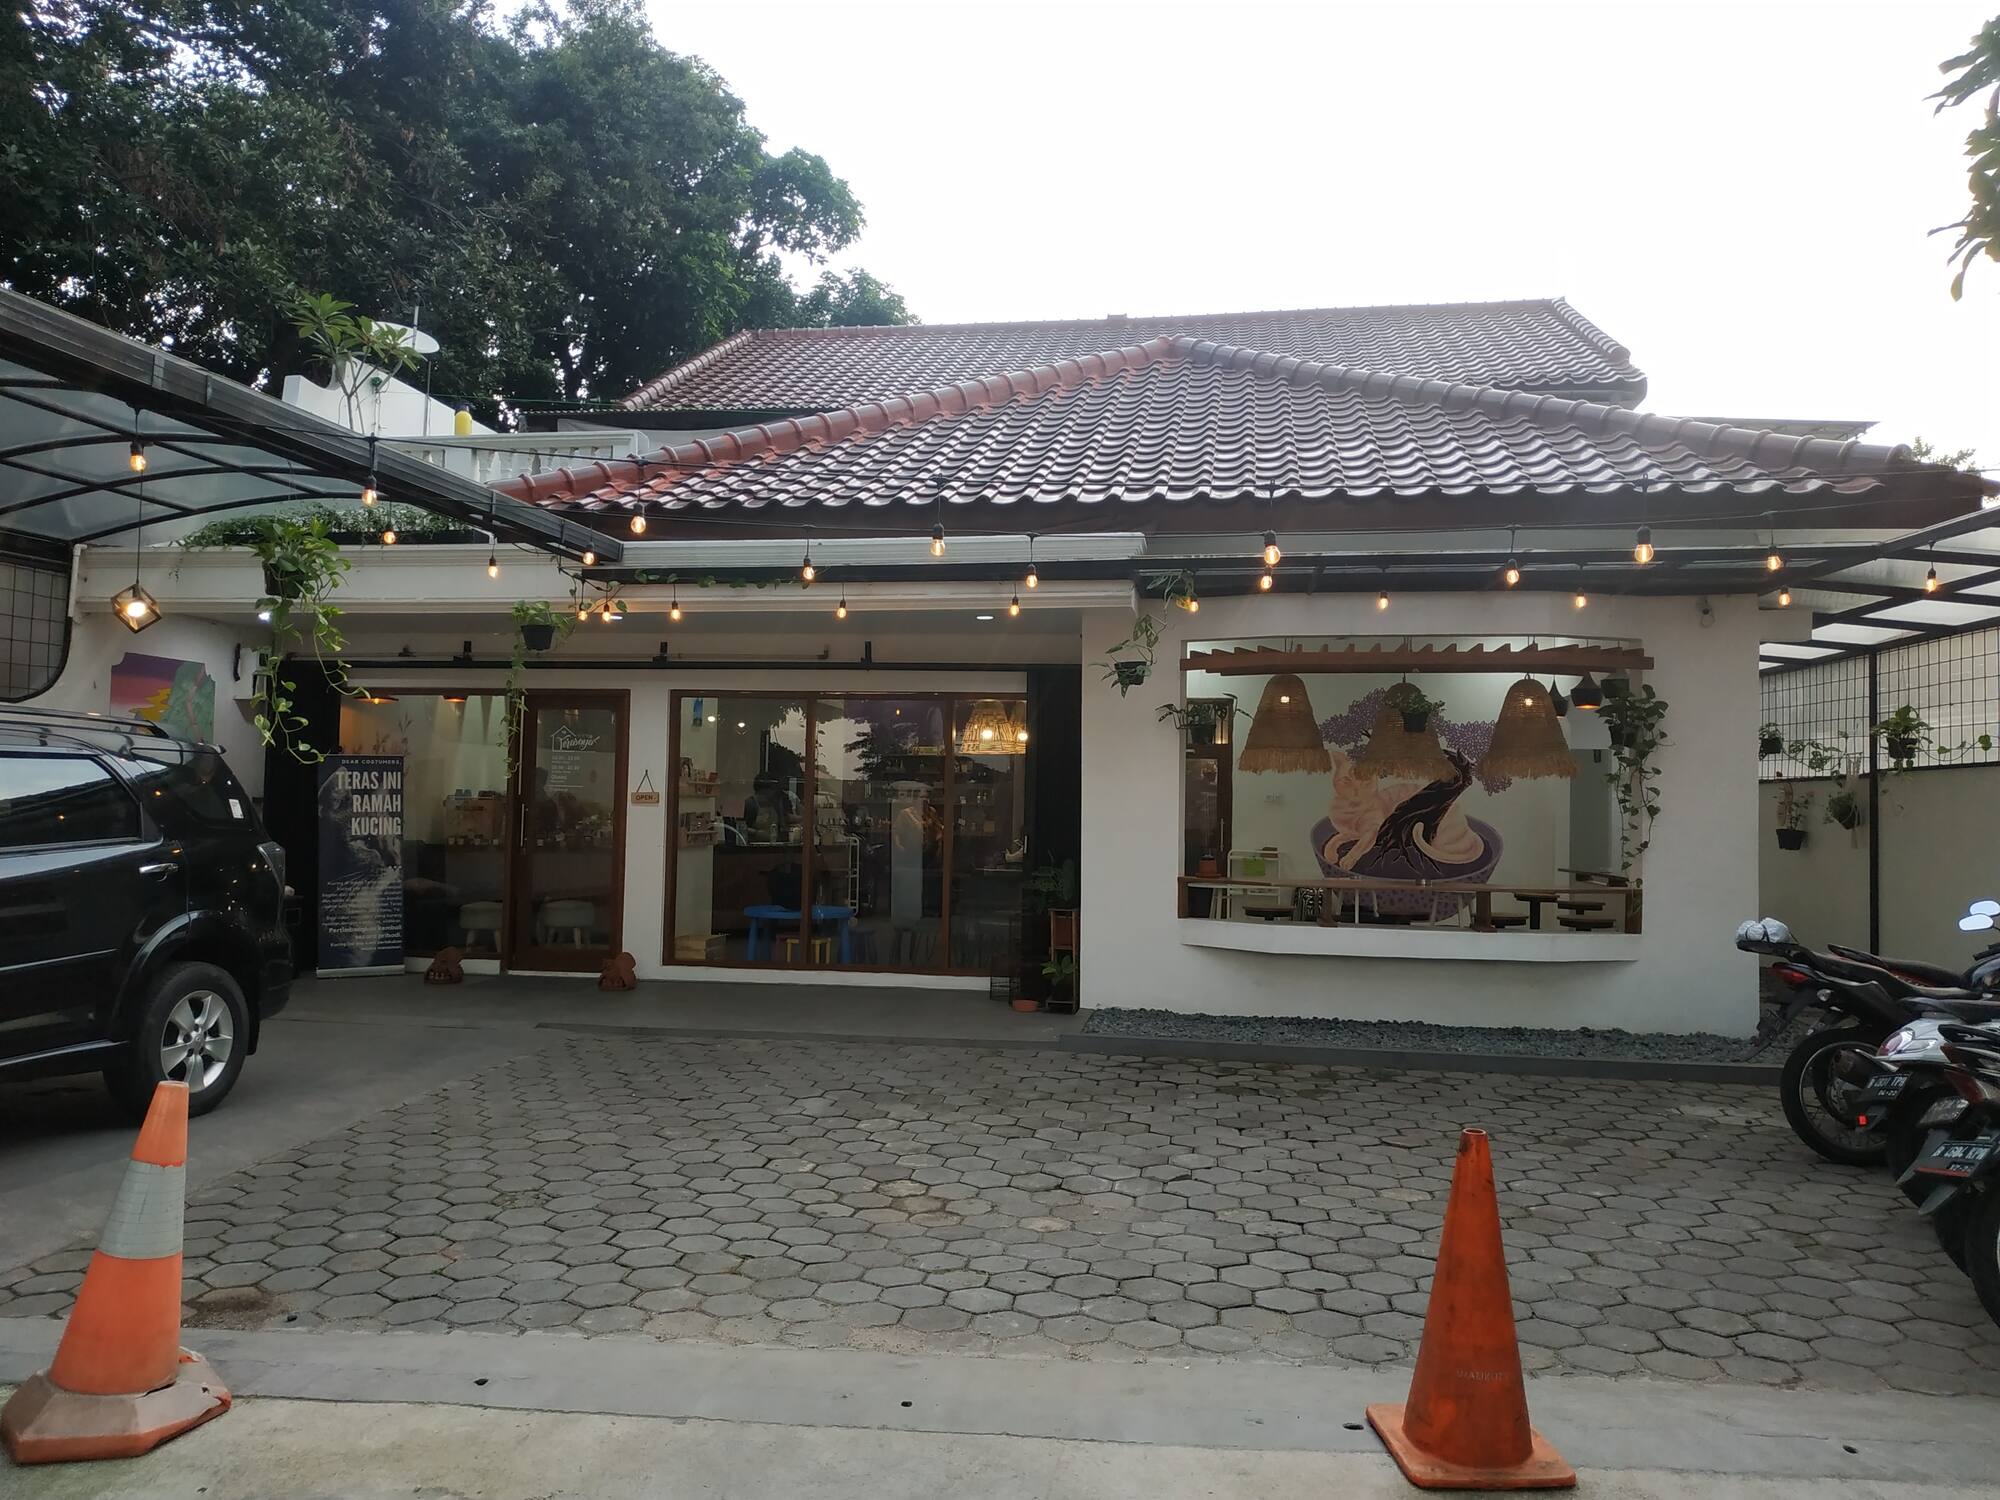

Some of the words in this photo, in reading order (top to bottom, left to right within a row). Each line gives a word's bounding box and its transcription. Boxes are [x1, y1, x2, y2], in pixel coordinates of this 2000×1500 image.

[335, 771, 379, 790] TERAS
[383, 771, 402, 790] INI
[352, 794, 402, 813] RAMAH
[351, 817, 402, 836] KUCING
